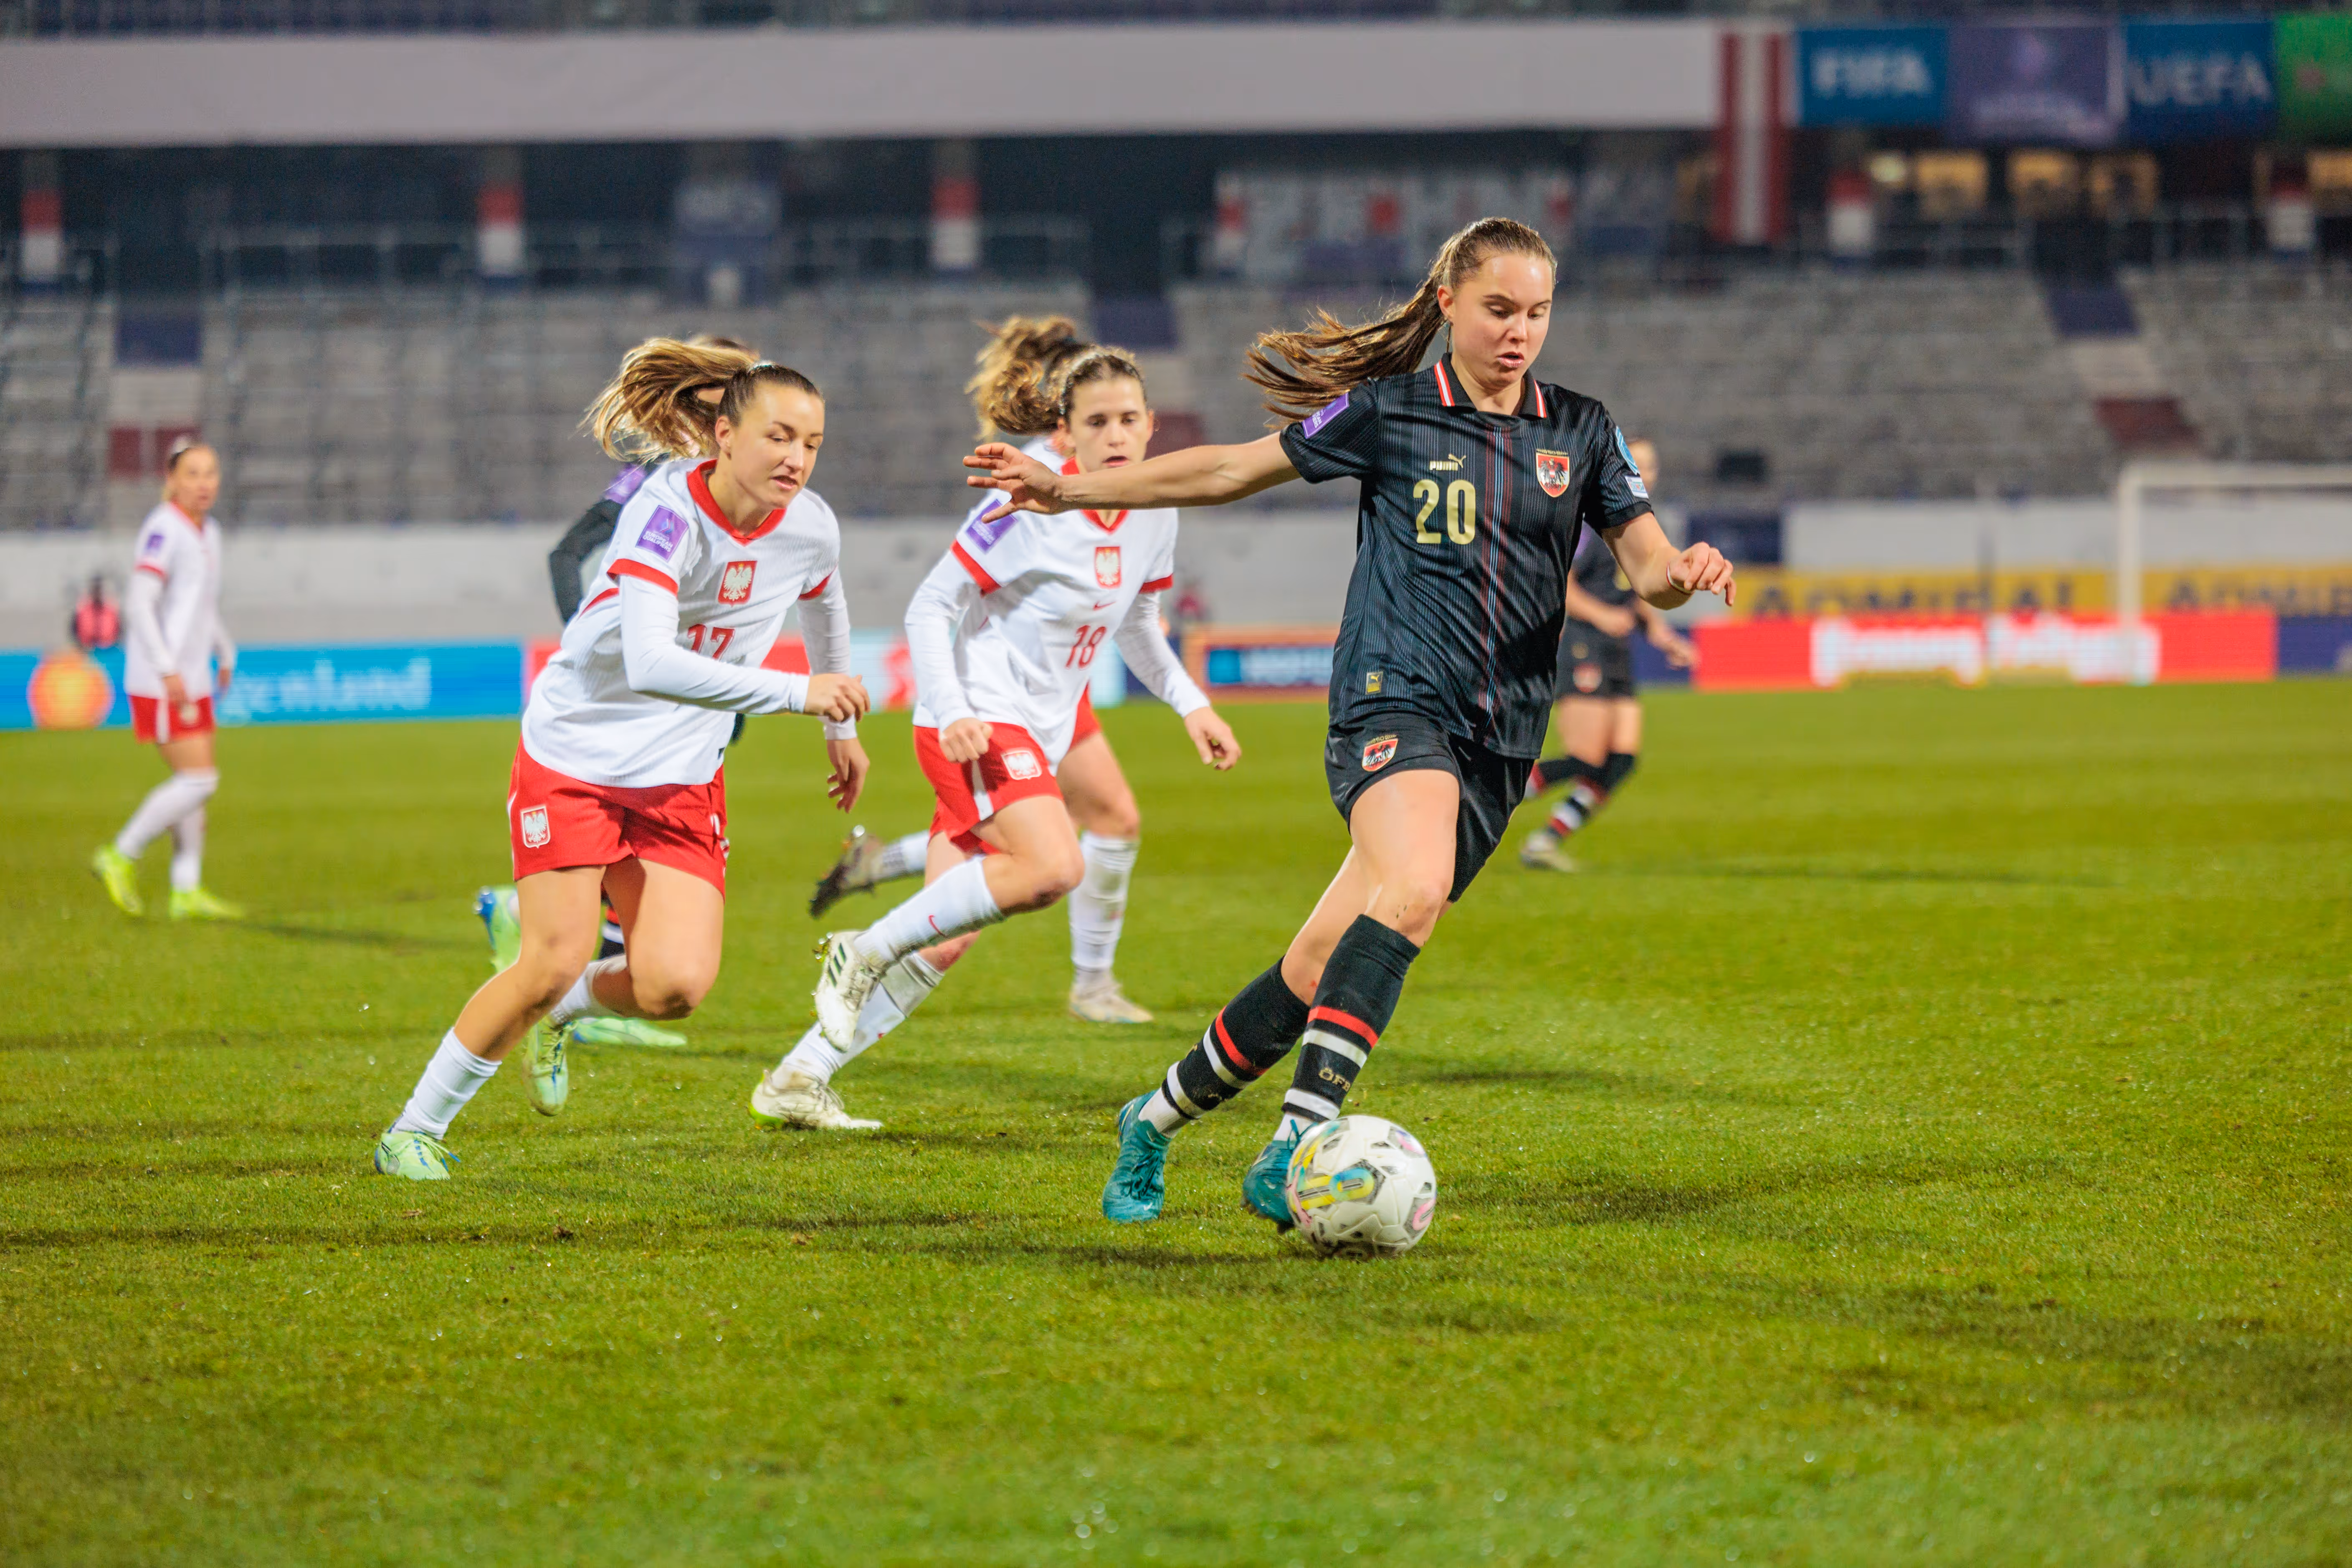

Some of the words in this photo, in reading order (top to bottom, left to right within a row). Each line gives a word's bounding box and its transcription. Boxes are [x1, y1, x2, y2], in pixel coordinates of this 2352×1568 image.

[2129, 54, 2273, 104] UEFA
[1413, 479, 1476, 545] 20
[687, 624, 735, 660] 17
[1066, 625, 1106, 670] 18
